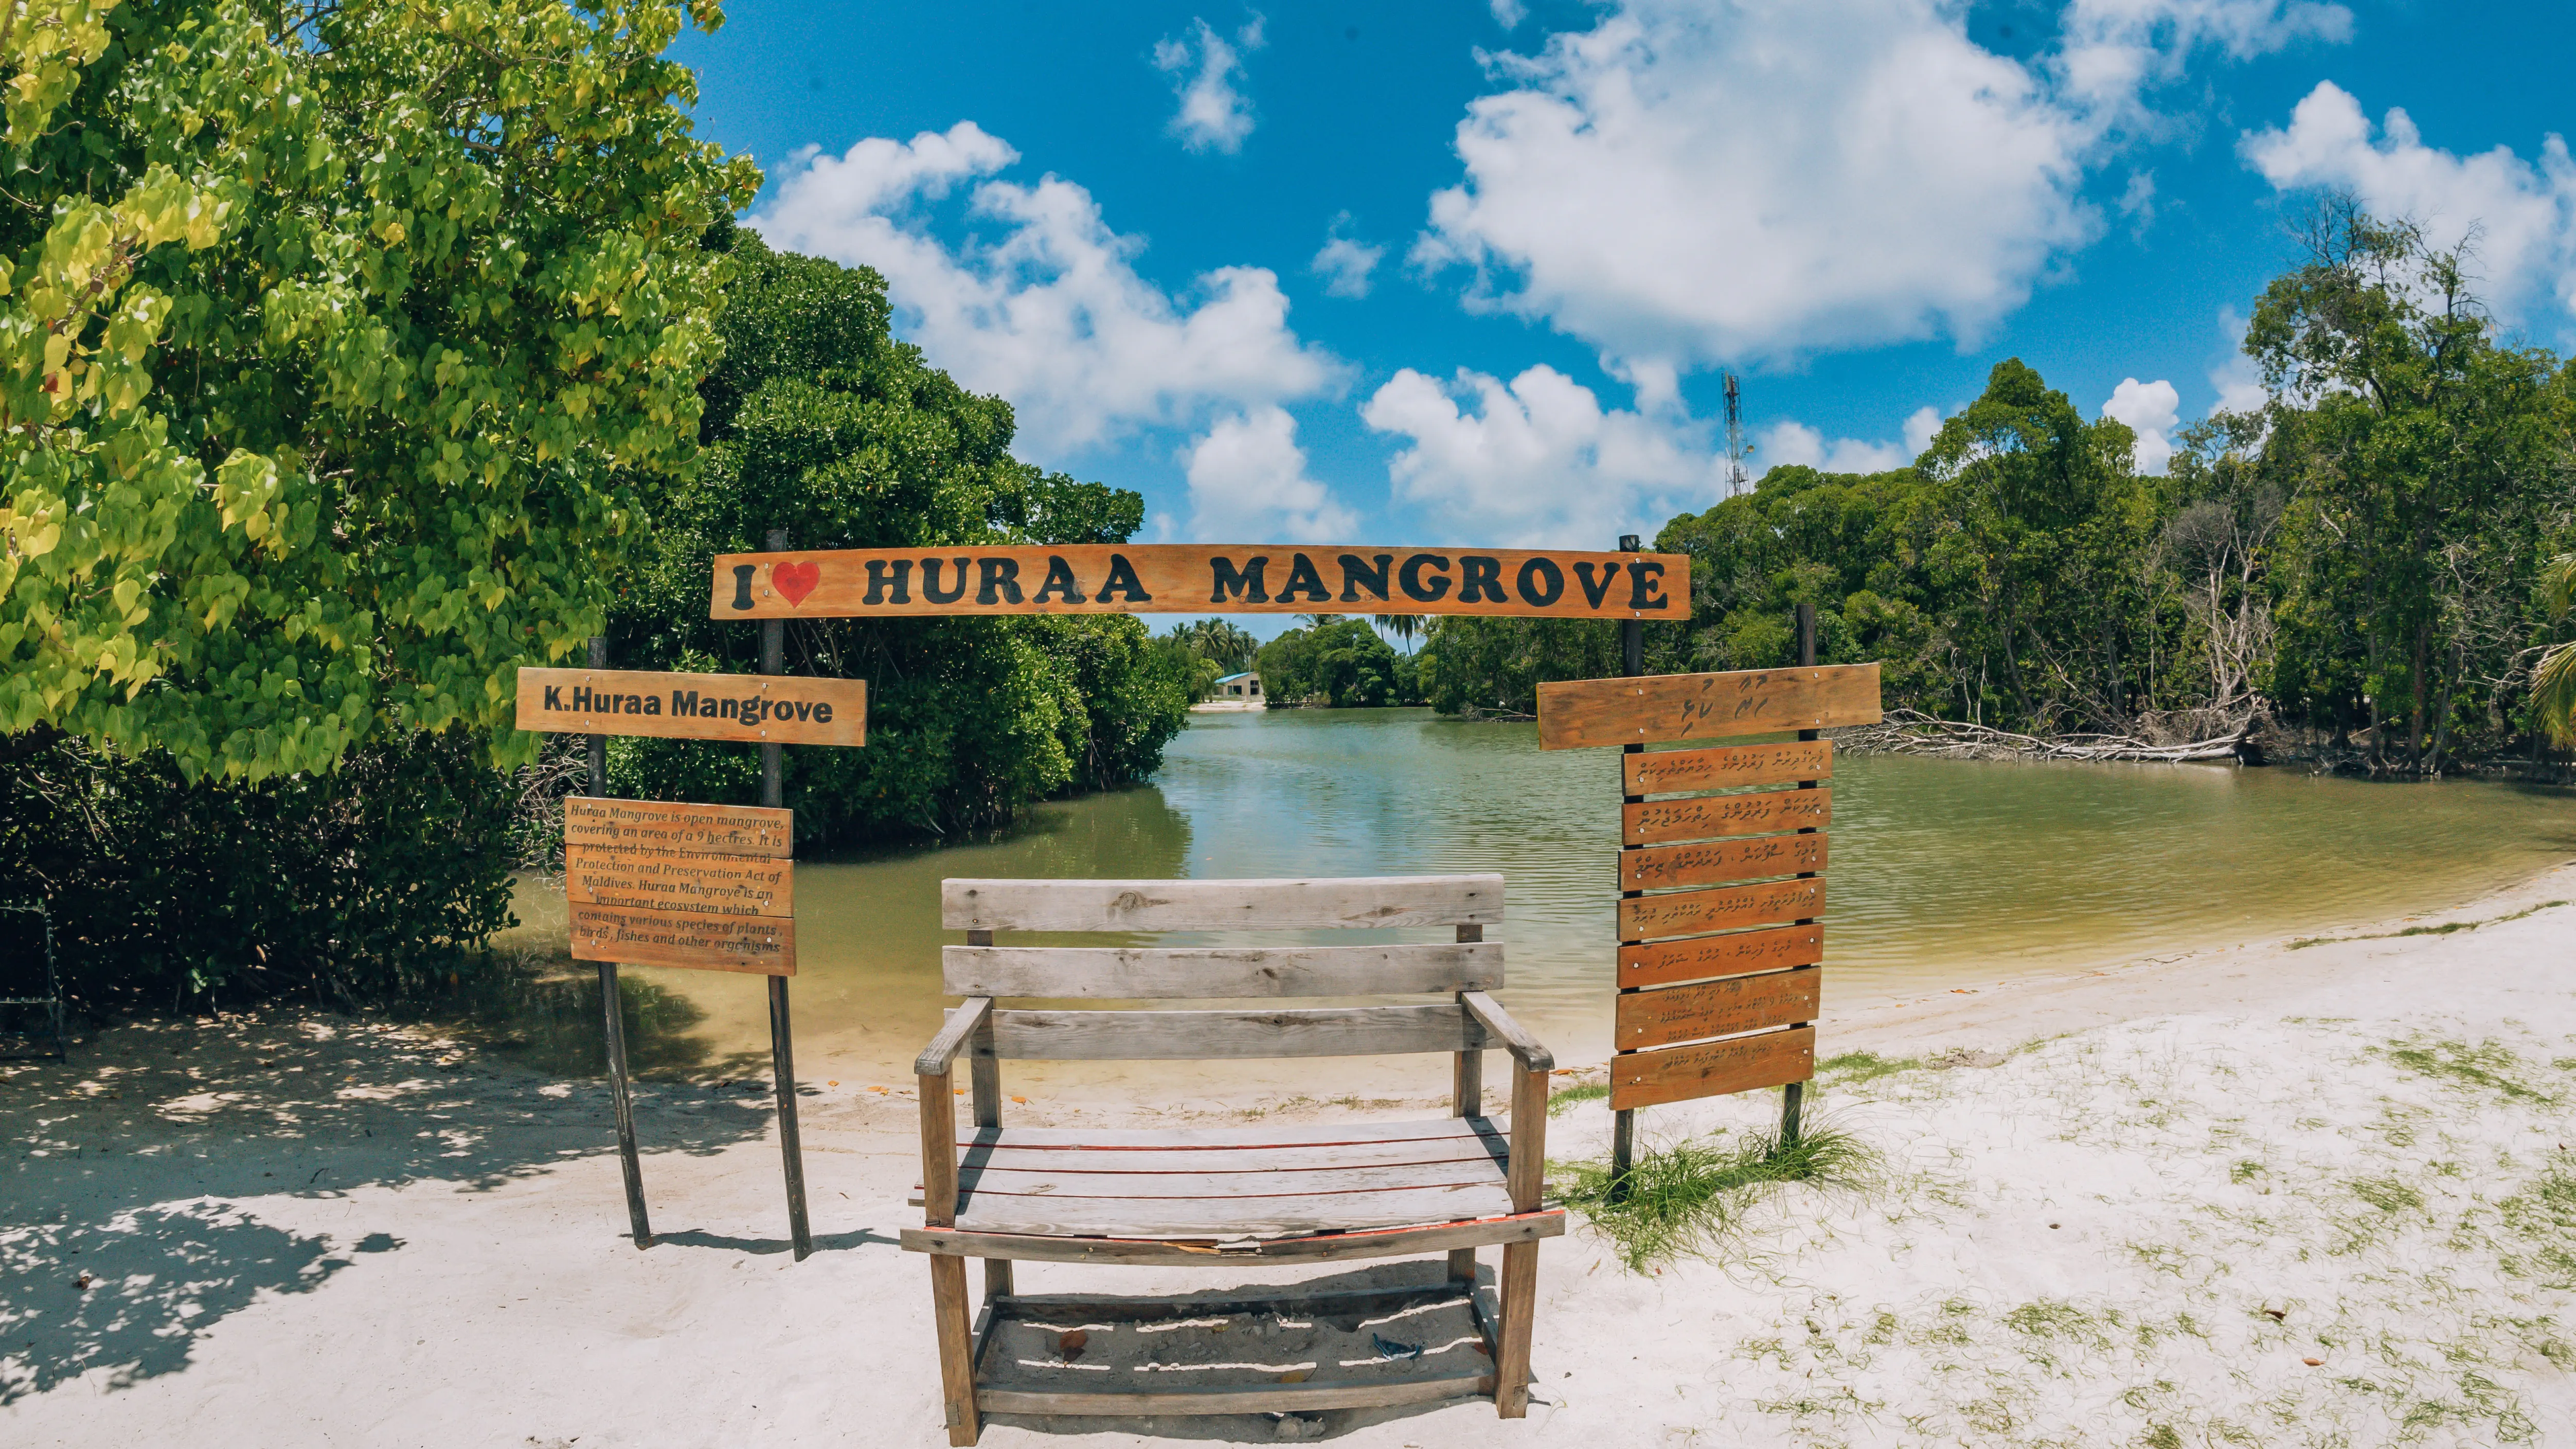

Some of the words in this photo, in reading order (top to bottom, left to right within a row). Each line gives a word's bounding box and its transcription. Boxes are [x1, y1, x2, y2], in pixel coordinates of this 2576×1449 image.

[731, 564, 756, 611] I
[862, 553, 1153, 606] HURAA
[1209, 552, 1669, 611] MANGROVE
[544, 685, 661, 716] K.Huraa
[671, 690, 833, 727] Mangrove
[570, 804, 606, 818] Huraa
[609, 807, 668, 823] Mangrove
[671, 811, 680, 822] is
[684, 815, 713, 828] open
[717, 816, 785, 830] mangrove,
[571, 824, 620, 839] covering
[623, 828, 638, 838] an
[641, 829, 668, 839] area
[671, 829, 685, 844] of
[686, 833, 693, 842] a
[697, 830, 704, 842] 9
[759, 834, 770, 846] It
[772, 835, 782, 848] is
[583, 842, 637, 855] protected
[640, 844, 655, 859] by
[656, 846, 676, 858] the
[575, 857, 634, 872] Protection
[638, 863, 660, 874] and
[663, 864, 741, 879] Preservation
[745, 869, 765, 881] Act
[768, 871, 783, 885] of
[582, 875, 635, 889] Maldives.
[638, 880, 676, 893] Huraa
[679, 882, 741, 899] Mangrove
[743, 887, 754, 899] is
[756, 890, 773, 900] an
[722, 903, 760, 916] which
[578, 911, 627, 925] contains
[629, 915, 673, 927] various
[675, 919, 719, 932] species
[722, 921, 737, 934] of
[616, 928, 650, 942] fishes
[653, 934, 675, 945] and
[678, 935, 709, 948] other
